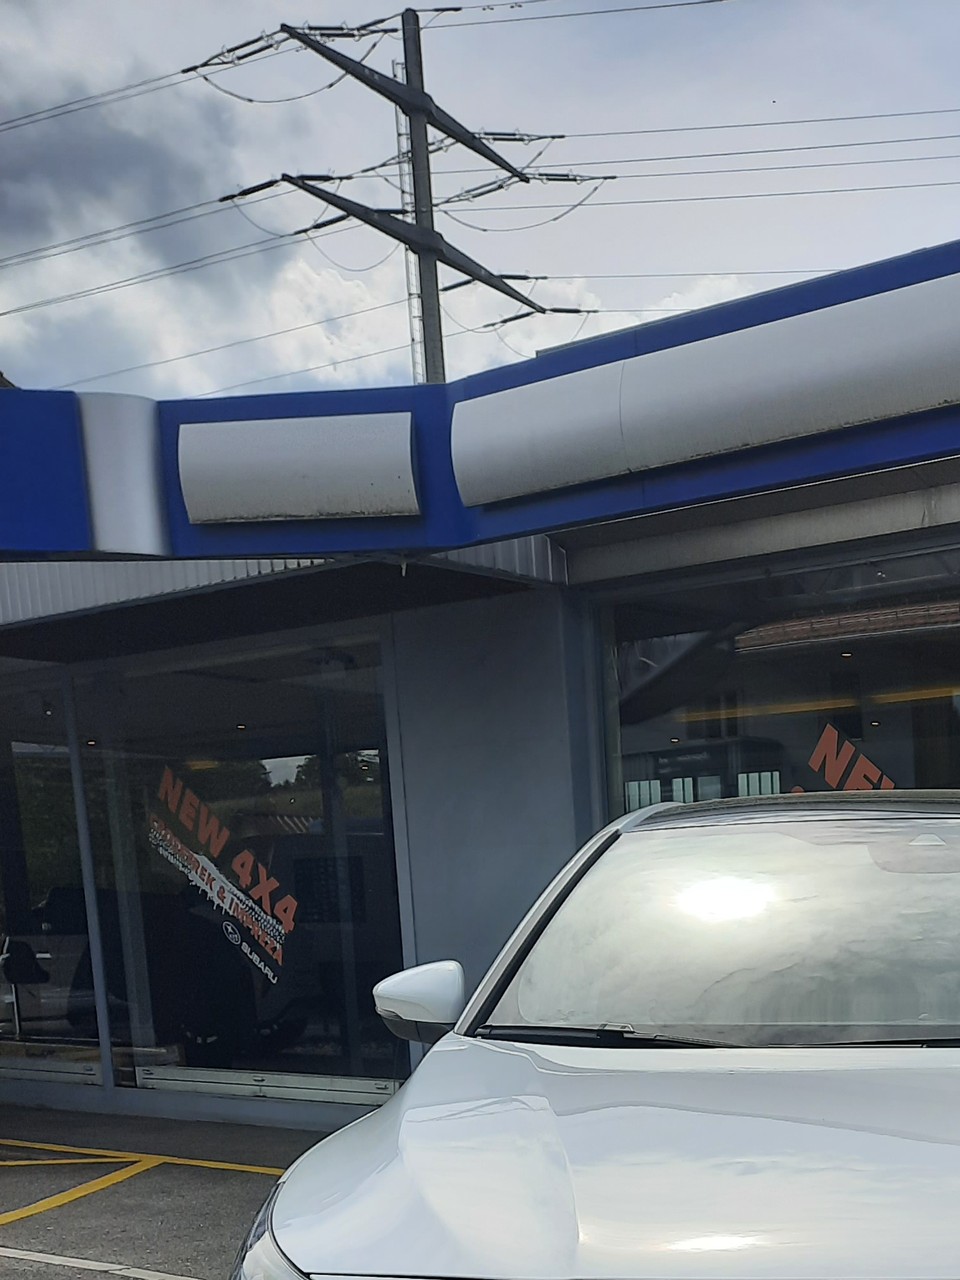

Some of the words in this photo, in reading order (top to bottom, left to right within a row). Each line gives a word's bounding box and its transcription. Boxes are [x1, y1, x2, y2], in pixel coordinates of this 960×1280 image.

[808, 723, 896, 790] NE
[158, 766, 230, 858] NEW
[232, 850, 298, 934] 4X4
[240, 942, 278, 984] SUBARU
